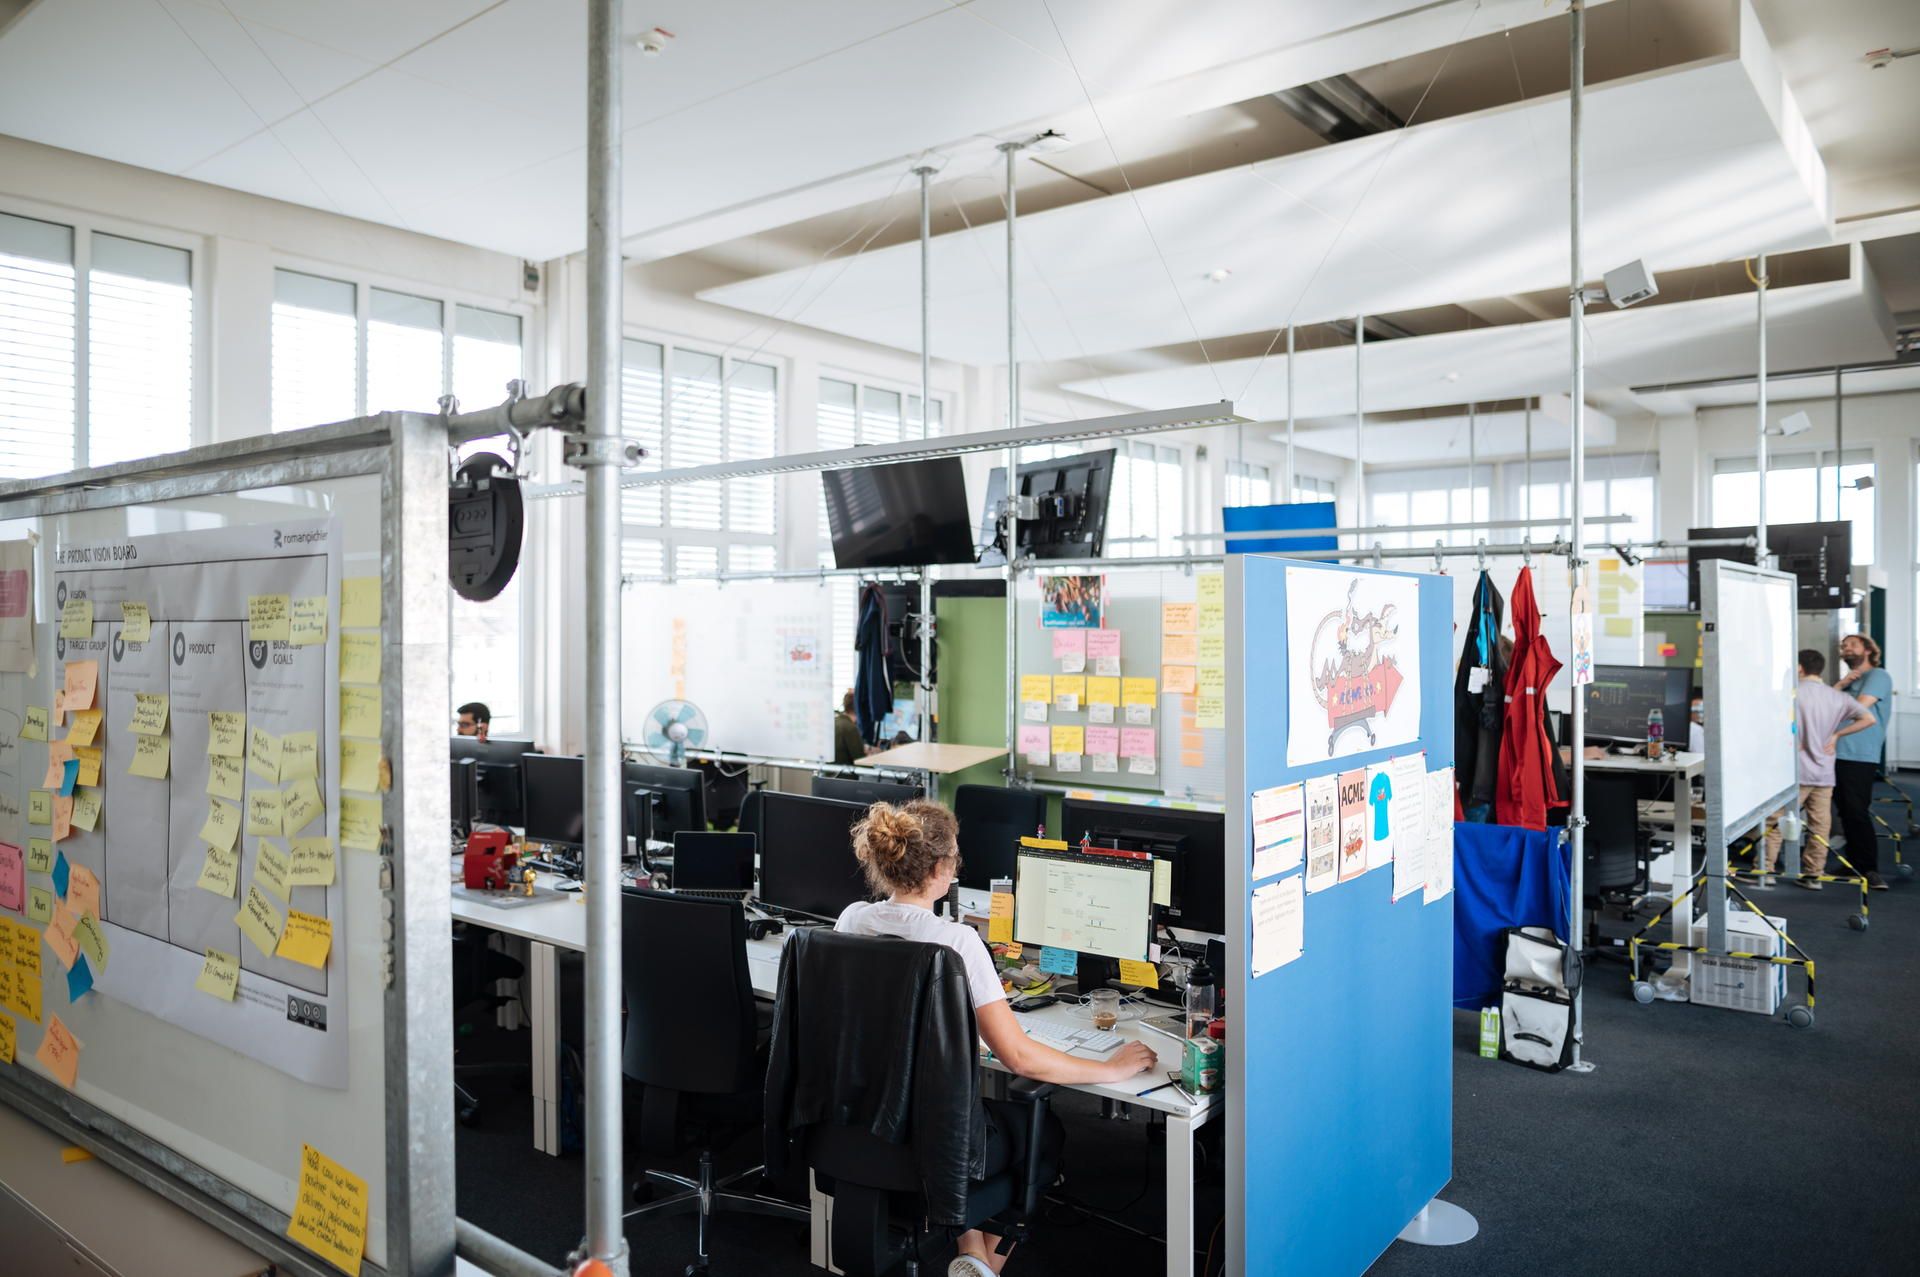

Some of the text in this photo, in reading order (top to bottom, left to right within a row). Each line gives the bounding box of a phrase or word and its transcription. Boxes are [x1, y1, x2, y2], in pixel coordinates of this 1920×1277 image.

[67, 548, 91, 562] PRODUCT
[93, 546, 111, 561] VISION
[112, 545, 137, 560] BOARD
[70, 590, 87, 599] VISION
[69, 640, 107, 651] TARGET GROUP
[189, 643, 216, 655] PRODUCT
[273, 654, 293, 665] GOALS
[1341, 781, 1365, 807] ACME
[31, 847, 49, 870] Deploy
[34, 896, 46, 911] Run
